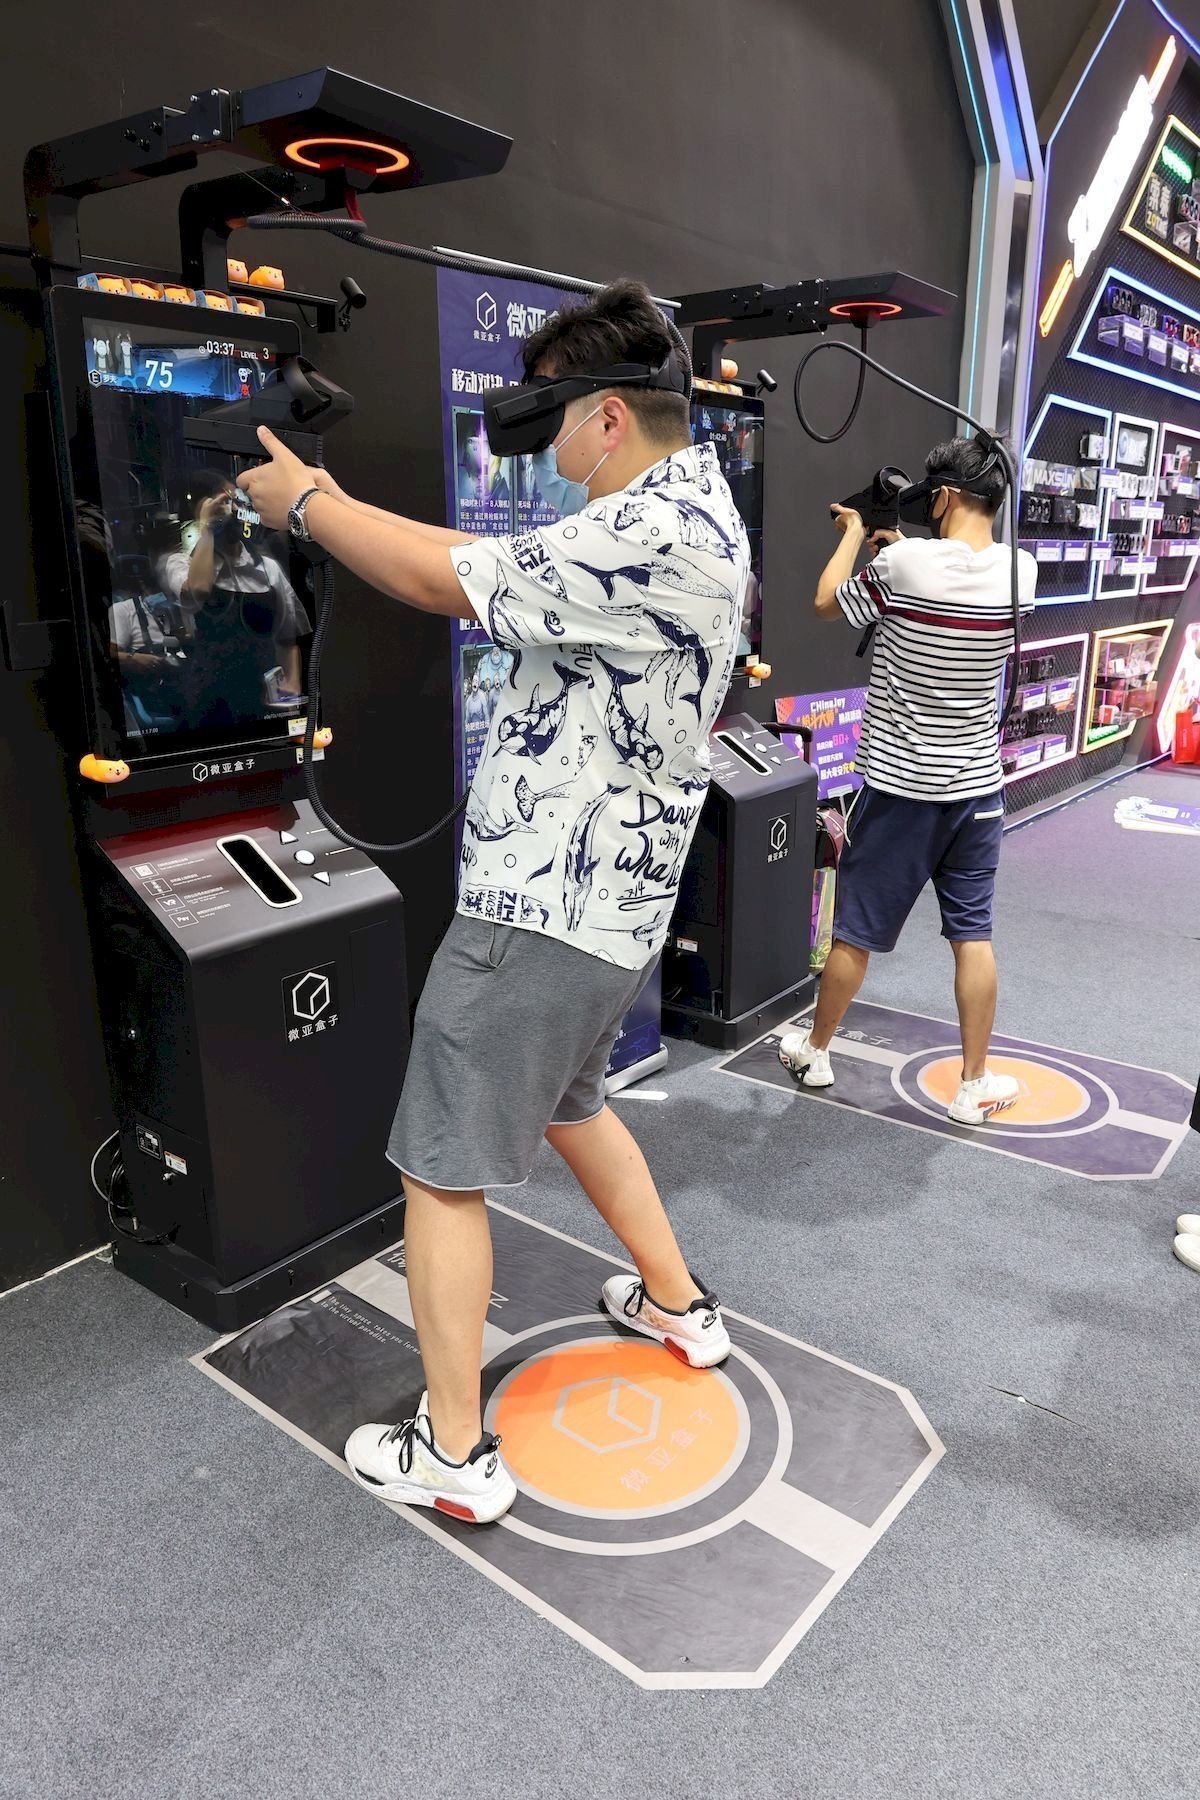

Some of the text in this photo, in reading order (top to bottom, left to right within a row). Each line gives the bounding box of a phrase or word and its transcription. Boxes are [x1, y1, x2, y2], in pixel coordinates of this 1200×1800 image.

[506, 301, 560, 339] 微亚
[206, 340, 235, 356] 03:37
[240, 348, 269, 360] LEVEL 3
[145, 360, 174, 388] 75
[1034, 467, 1076, 490] MAXSUN
[237, 508, 261, 525] COMBO
[242, 521, 252, 538] 5
[510, 534, 538, 554] LOOSE
[517, 549, 551, 572] 714
[210, 758, 255, 775] 微亚盒子
[485, 889, 498, 921] LOOSE
[501, 891, 517, 923] 714
[288, 1014, 339, 1042] 微亚盒子
[329, 1305, 340, 1314] the
[339, 1313, 361, 1327] virtual
[353, 1313, 372, 1325] space
[704, 1311, 718, 1324] NIKE
[619, 1407, 714, 1493] 微亚盒子
